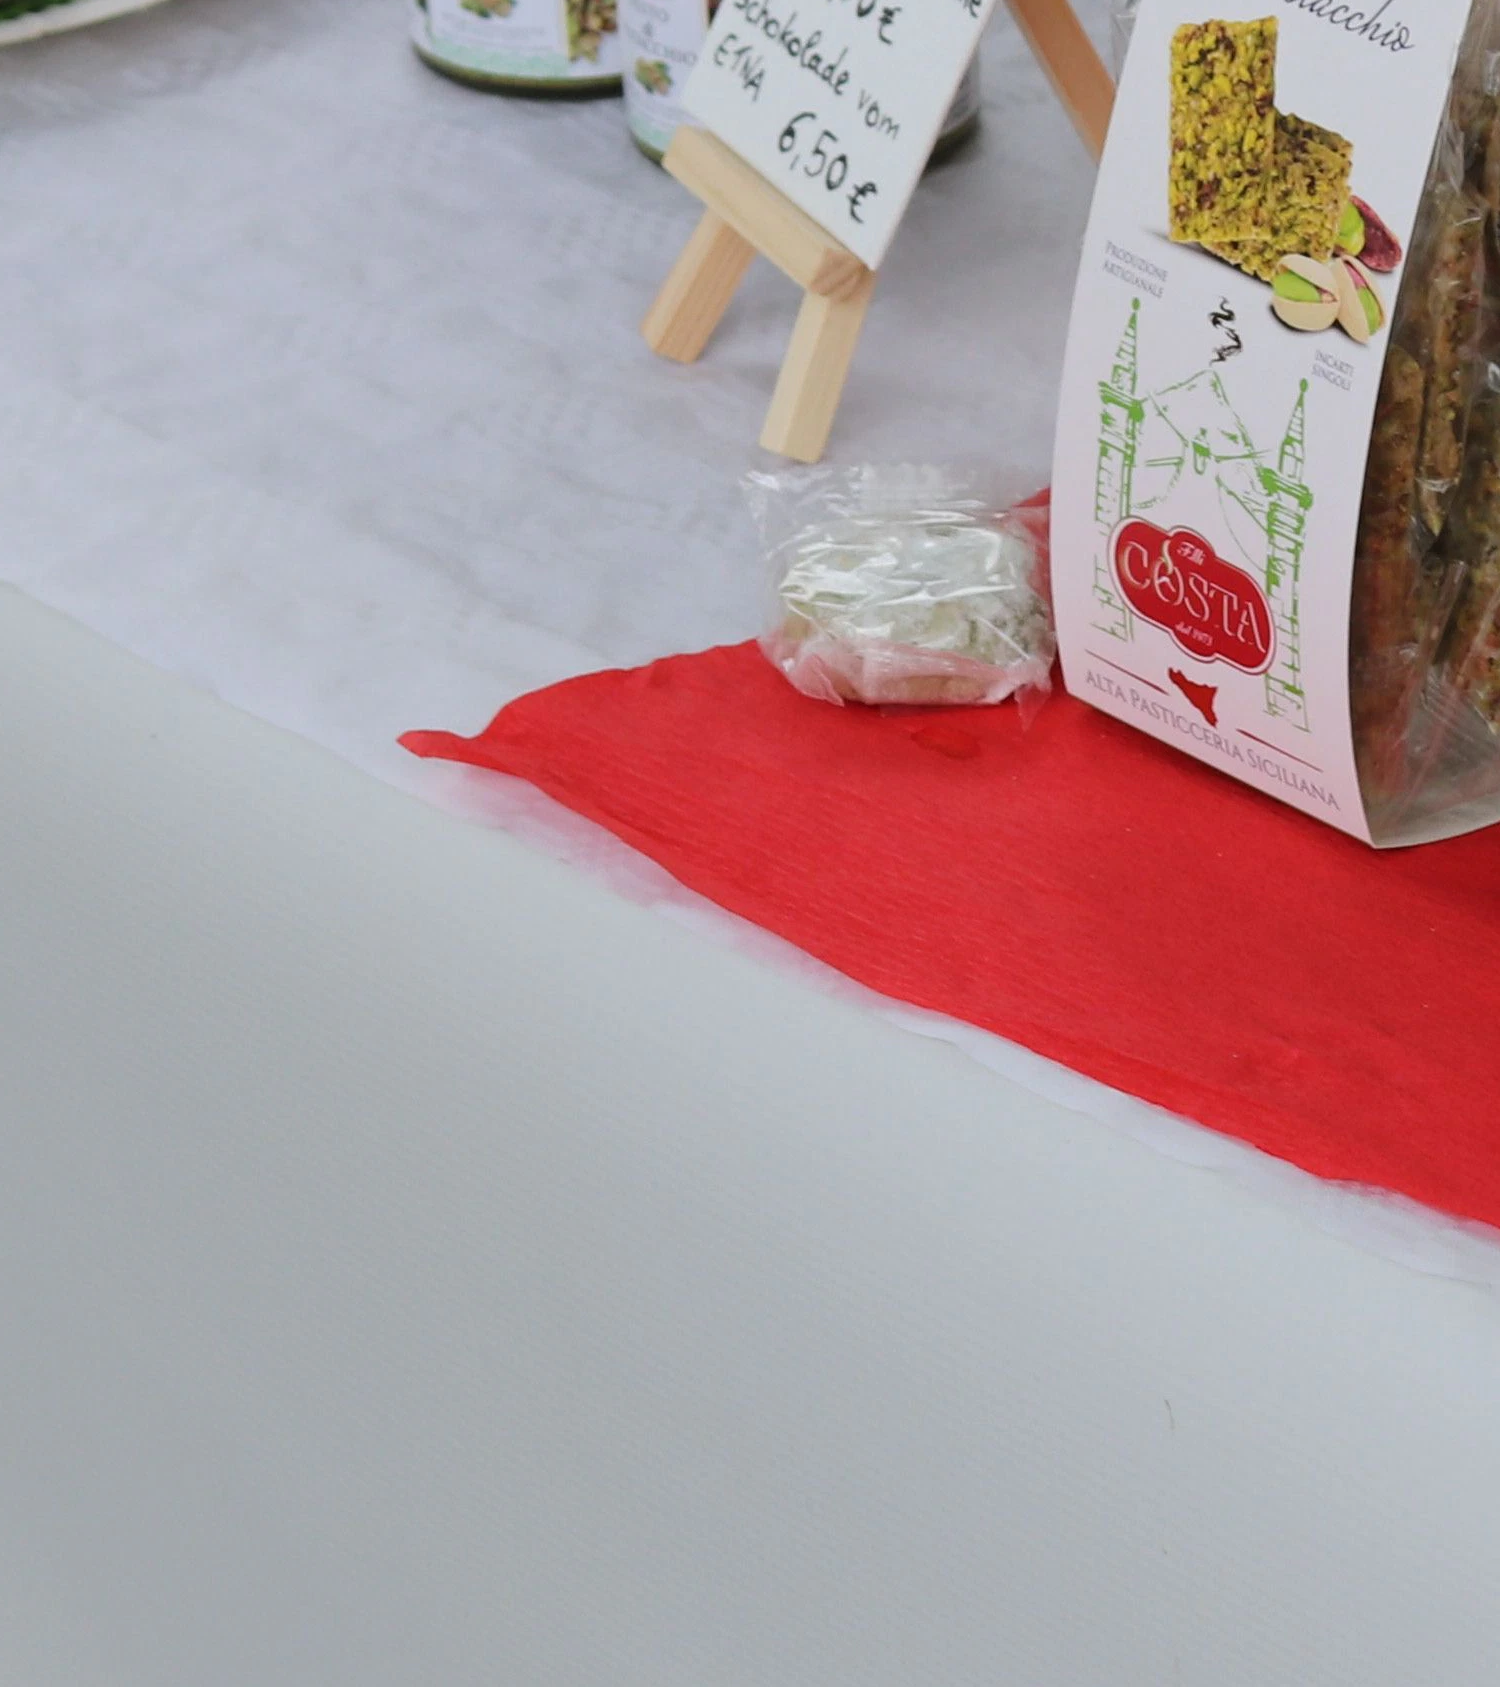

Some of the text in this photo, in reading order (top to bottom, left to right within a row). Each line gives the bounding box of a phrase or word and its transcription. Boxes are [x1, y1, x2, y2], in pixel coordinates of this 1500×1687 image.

[857, 85, 901, 140] vom
[1102, 259, 1165, 301] ARTIGIANALE
[1103, 241, 1170, 284] PRODUZIONE
[1310, 361, 1352, 393] SINGOLI
[1313, 348, 1355, 378] INCARTI
[1119, 539, 1268, 654] COSTA
[1085, 669, 1341, 813] ALTA PASTICCERIA SICILIANA
